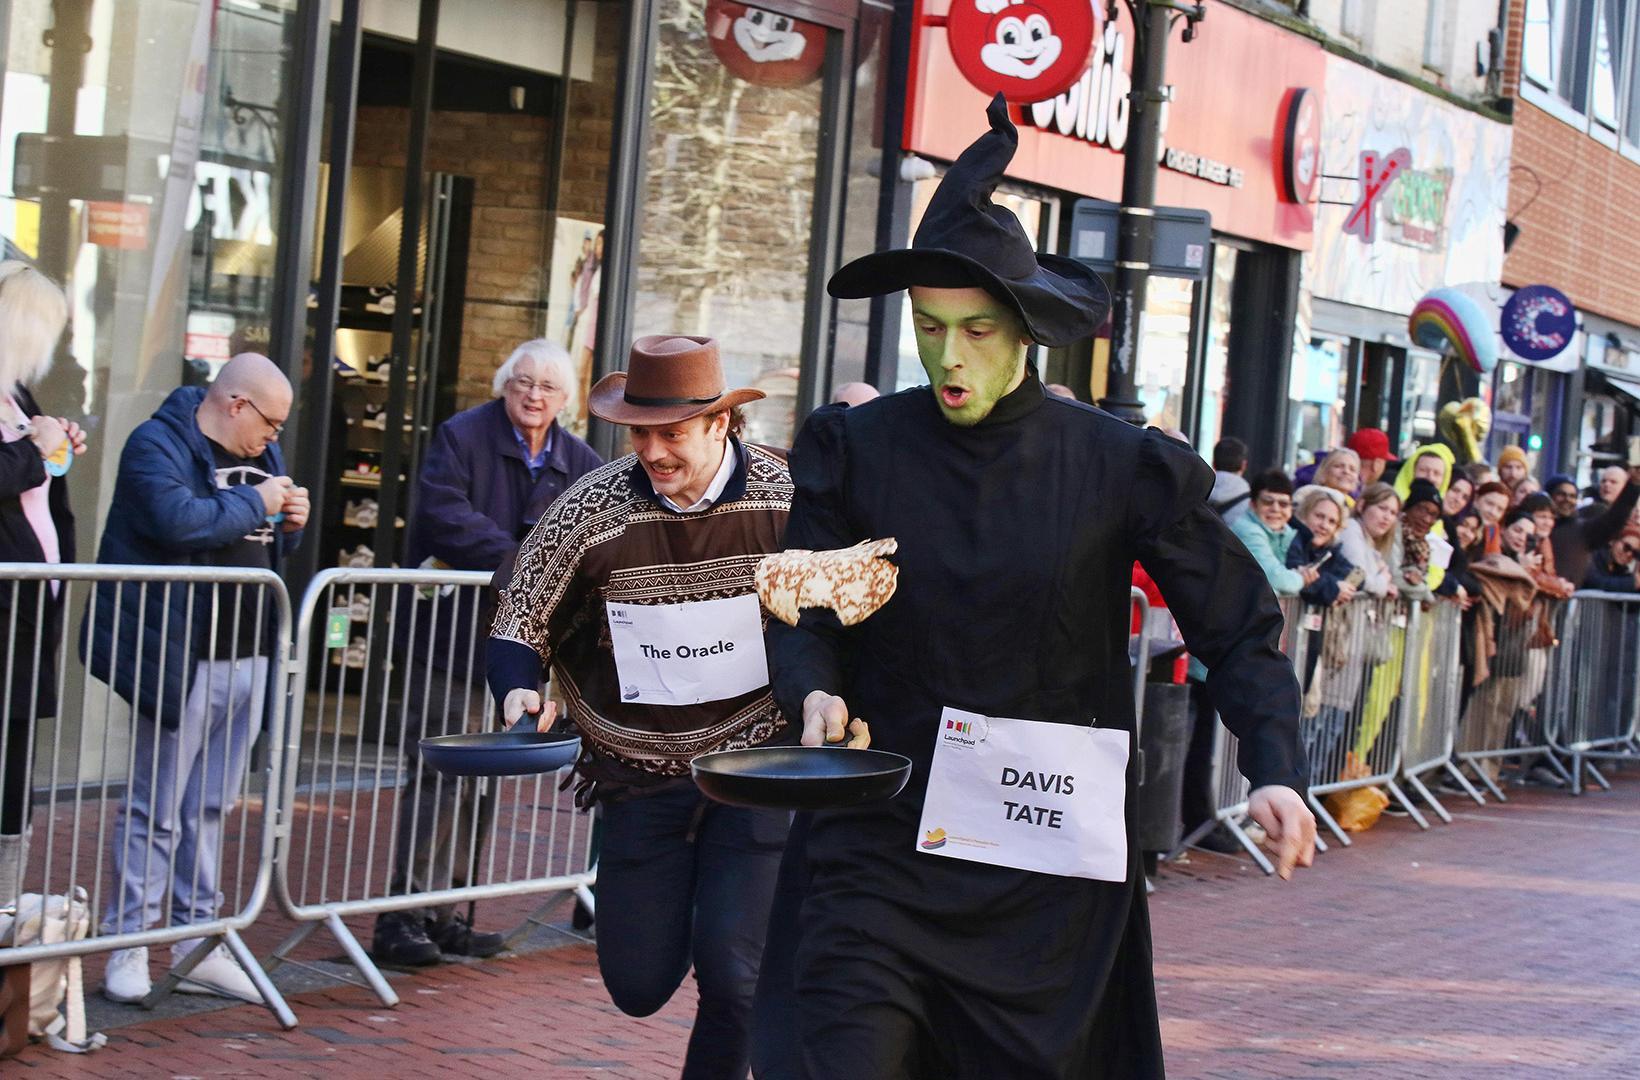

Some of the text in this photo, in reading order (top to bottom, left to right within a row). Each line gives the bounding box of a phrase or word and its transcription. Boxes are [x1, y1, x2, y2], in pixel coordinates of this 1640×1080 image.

[640, 640, 735, 659] The Oracle
[944, 733, 976, 746] Launchpad
[1001, 767, 1075, 796] DAVIS
[1003, 800, 1064, 829] TATE
